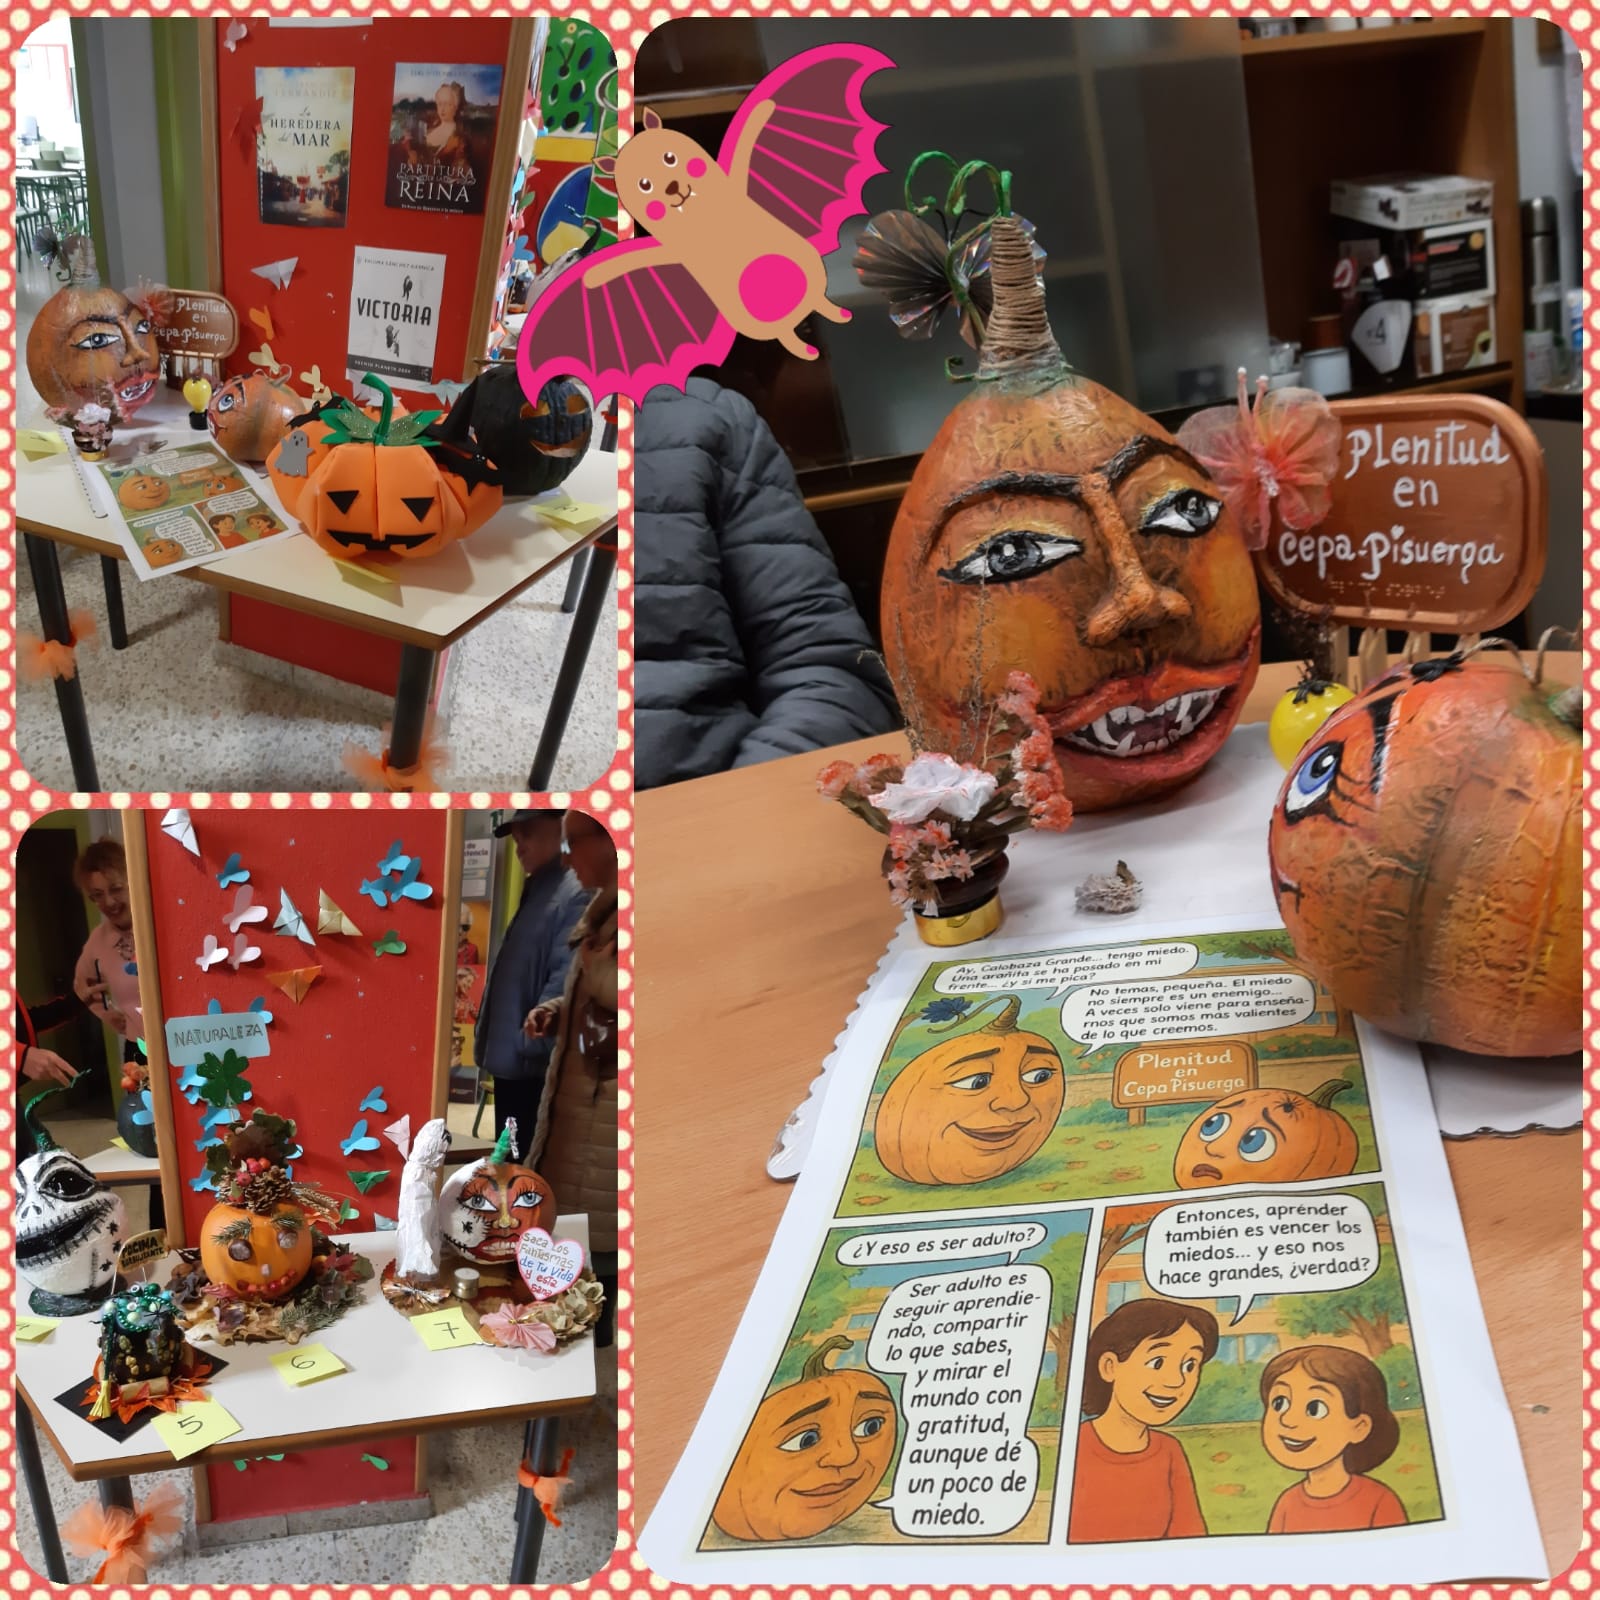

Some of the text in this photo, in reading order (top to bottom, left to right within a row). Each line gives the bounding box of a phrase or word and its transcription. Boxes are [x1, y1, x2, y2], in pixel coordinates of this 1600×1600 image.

[270, 119, 341, 131] HEREDERA
[293, 132, 330, 147] MAR
[400, 162, 475, 179] PARTITURA
[400, 180, 470, 203] REINA
[175, 297, 229, 314] Plenitud
[357, 297, 432, 326] VICTORIA
[192, 313, 208, 323] en
[1344, 420, 1510, 480] Plenitud
[1393, 476, 1439, 508] en
[464, 848, 488, 857] tencia
[956, 966, 976, 975] Ay,
[1108, 950, 1143, 960] tengo
[1147, 946, 1189, 956] miedo.
[982, 970, 1029, 980] arañita
[1053, 966, 1069, 974] ha
[1073, 961, 1120, 974] posado
[1145, 957, 1162, 965] mi
[1060, 972, 1096, 983] pica?
[1089, 976, 1293, 996] No temas, pequeña. El miedo
[1085, 996, 1310, 1017] A veces solo viene para enseña-
[1110, 994, 1164, 1004] siempre
[1169, 993, 1185, 1001] es
[1189, 991, 1207, 999] un
[1211, 988, 1283, 998] enemigo...
[1083, 1007, 1297, 1028] rnos que somos mas valientes
[174, 1023, 263, 1048] NATURALEZA
[1080, 1024, 1218, 1040] de lo que creemos.
[1137, 1048, 1233, 1069] Plenitud
[1175, 1067, 1198, 1078] en
[1123, 1077, 1245, 1099] Cepa Pisuerga
[1176, 1207, 1260, 1224] Entonces,
[853, 1227, 1036, 1258] ¿Y eso es ser adulto?
[1165, 1219, 1362, 1244] también es vencer los
[519, 1256, 534, 1268] de
[1169, 1240, 1345, 1263] miedos... y eso nos
[1159, 1257, 1371, 1287] hace grandes, ¿verdad?
[910, 1273, 1028, 1298] Ser adulto es
[893, 1291, 1041, 1321] seguir aprendie-
[433, 1321, 460, 1340] 7
[887, 1312, 1028, 1339] ndo, compartir
[885, 1336, 1012, 1365] lo que sabes,
[291, 1354, 316, 1370] 6
[915, 1358, 1011, 1387] y mirar el
[910, 1387, 1022, 1408] mundo con
[177, 1414, 204, 1435] 5
[916, 1412, 1010, 1442] gratitud,
[909, 1440, 1022, 1470] aunque dé
[908, 1469, 1027, 1500] un poco de
[911, 1501, 985, 1525] miedo.
